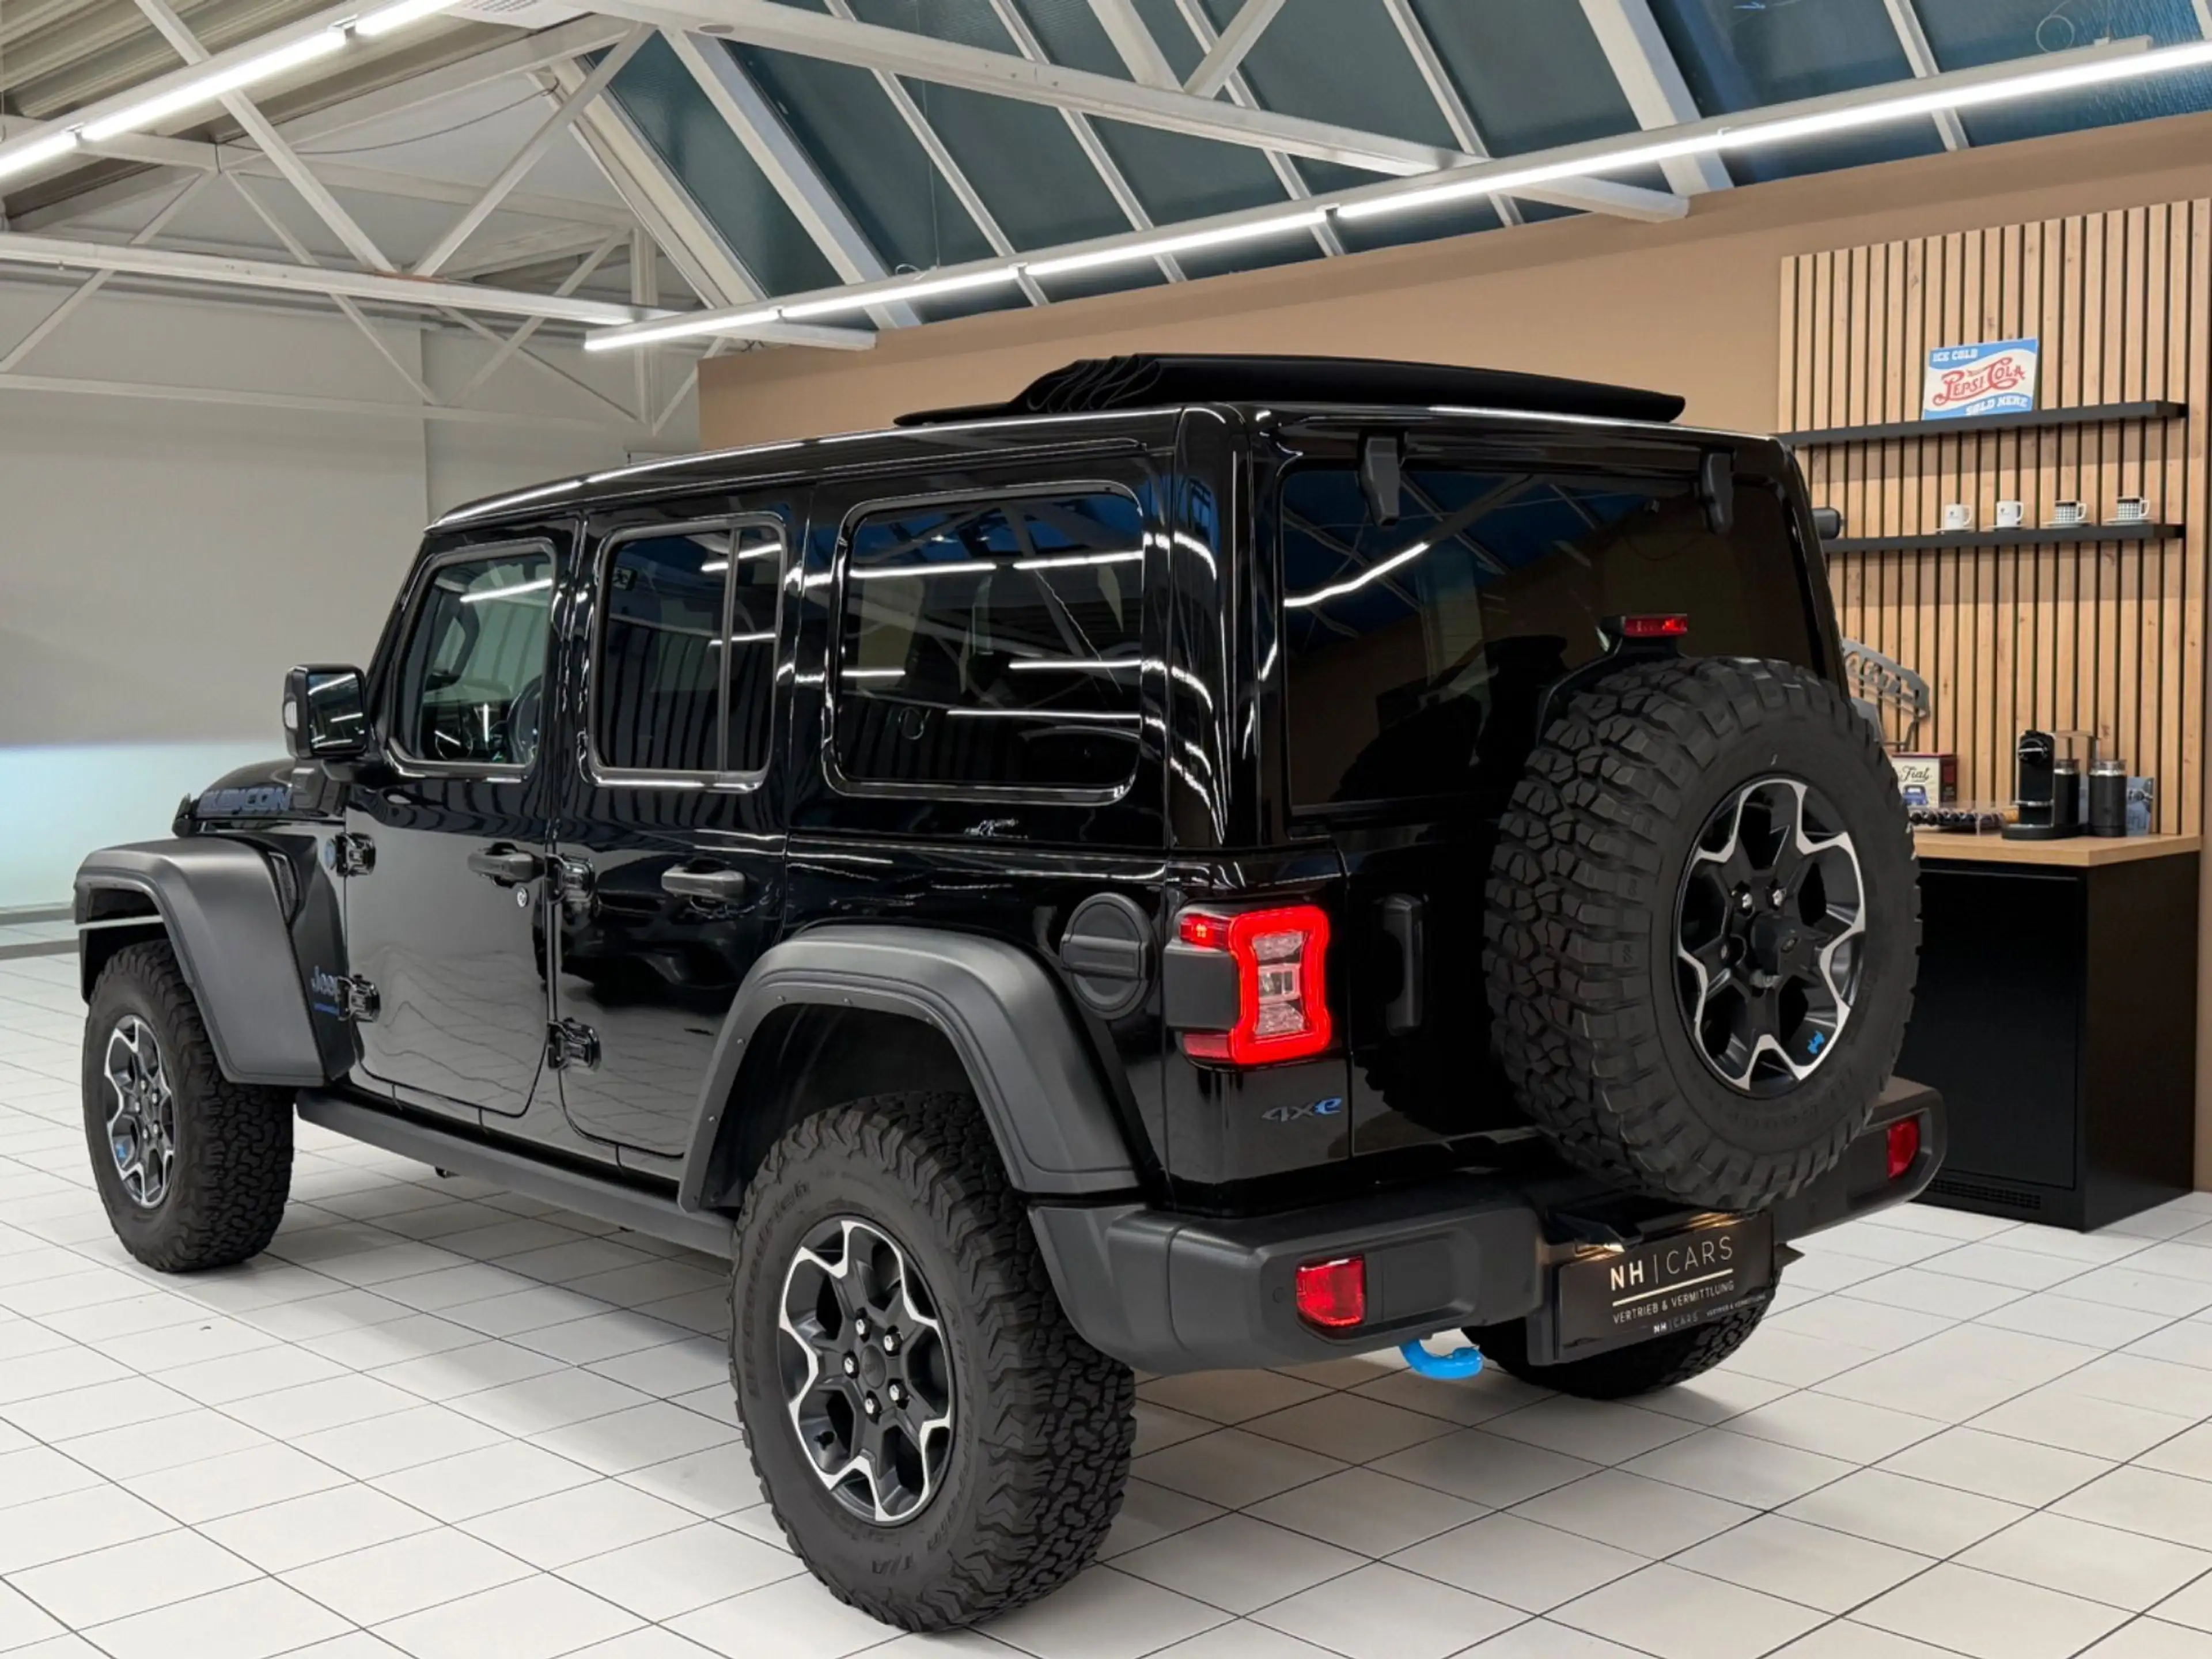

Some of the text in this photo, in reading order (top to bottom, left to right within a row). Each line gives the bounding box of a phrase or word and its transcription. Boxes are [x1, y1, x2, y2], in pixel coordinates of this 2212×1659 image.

[1933, 349, 1978, 362] ICE COLD
[1965, 396, 2028, 416] SOLD HERE
[1610, 1236, 1733, 1291] NH CARS
[1613, 1281, 1735, 1324] VERTRIEB & VERMITTLUNG
